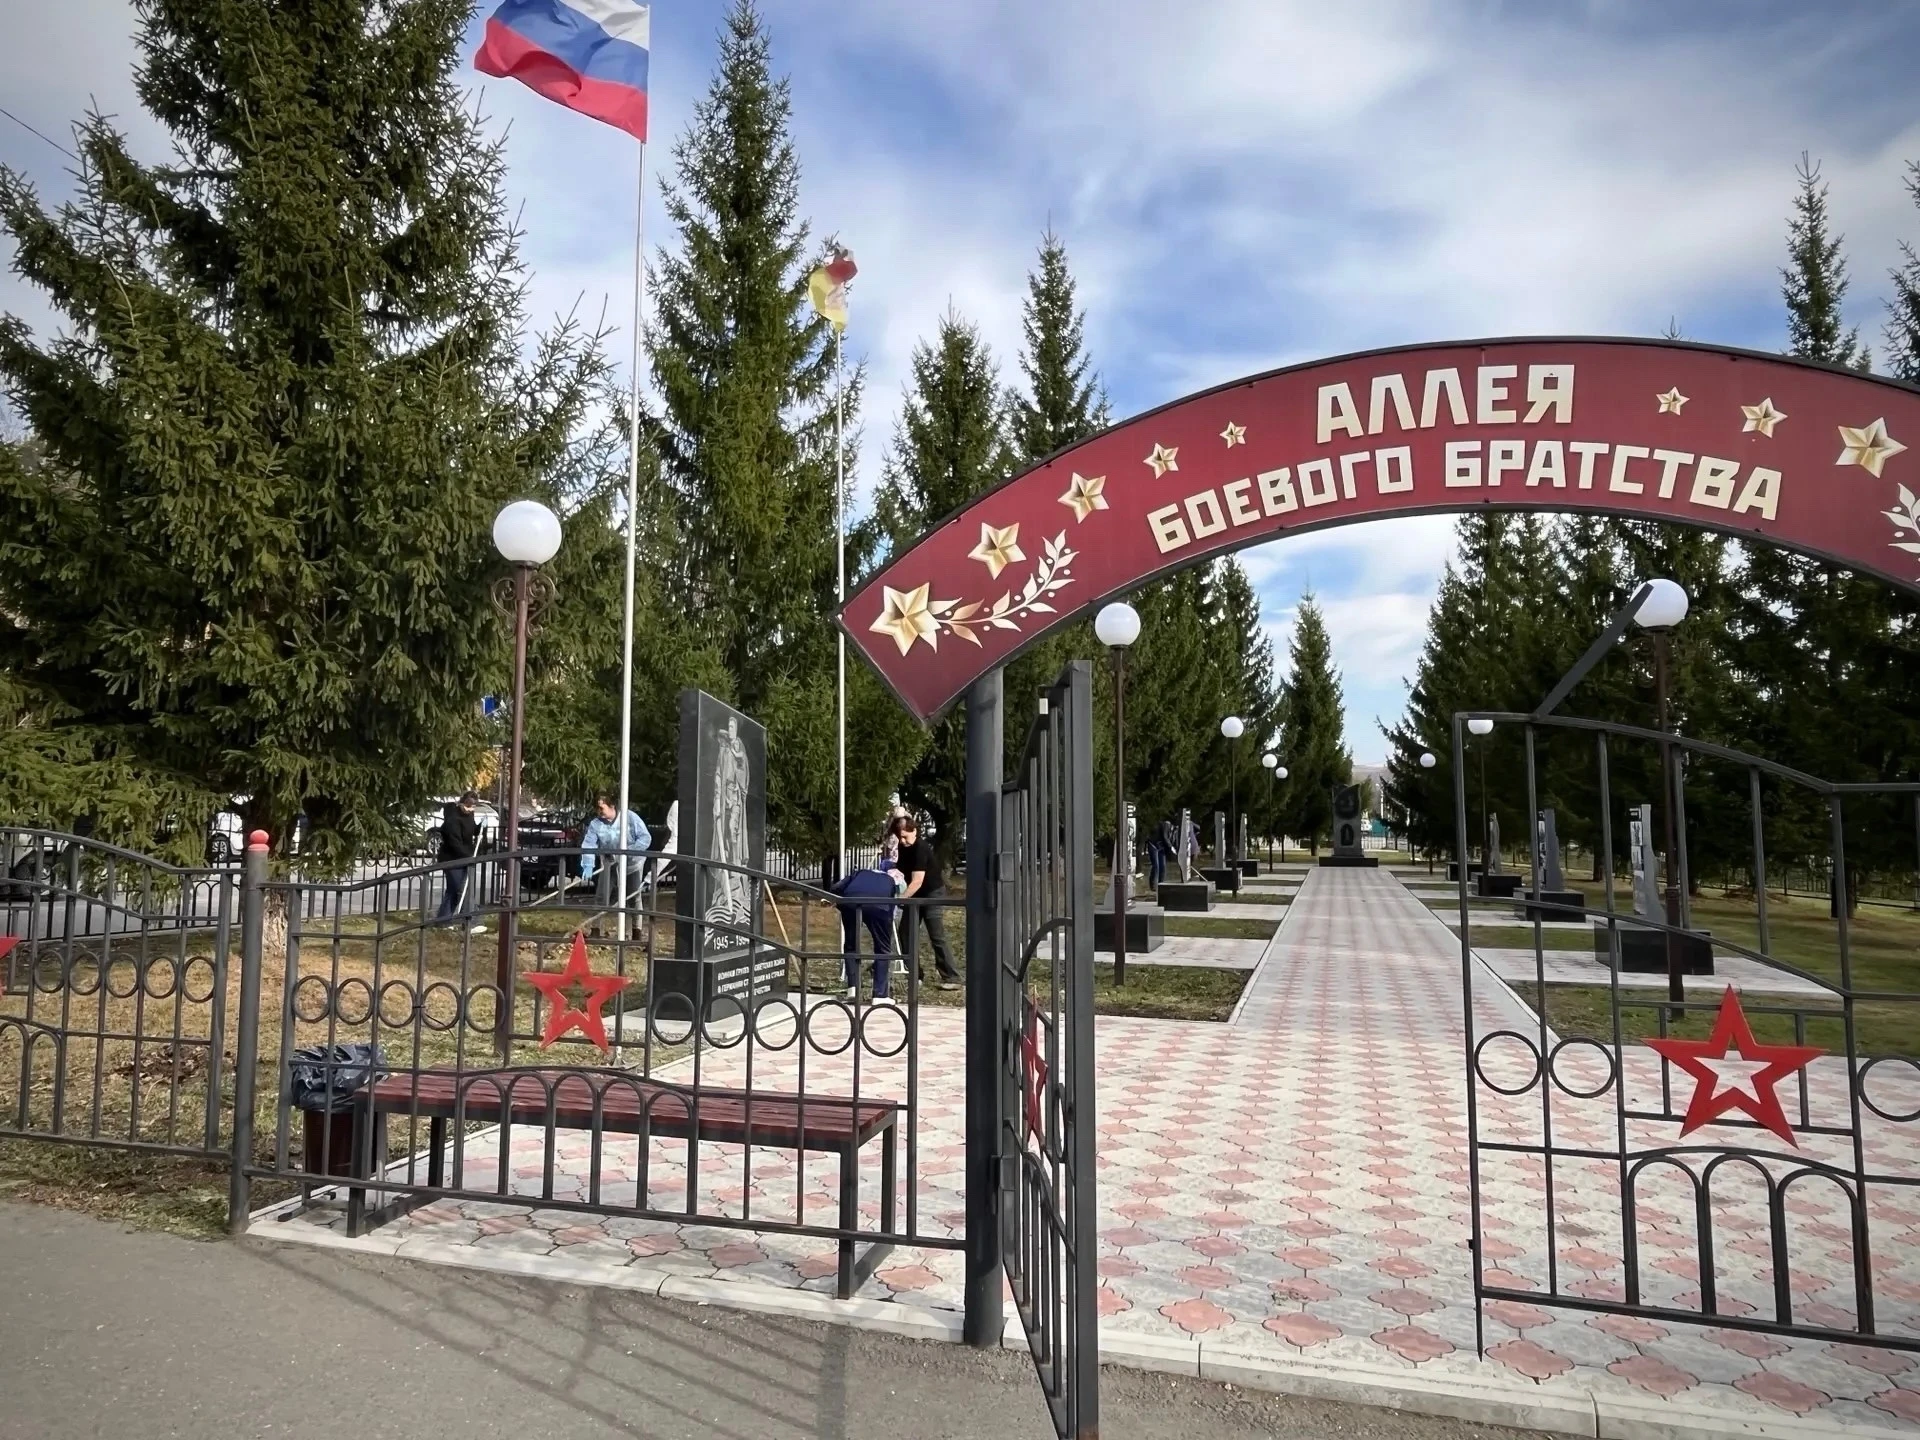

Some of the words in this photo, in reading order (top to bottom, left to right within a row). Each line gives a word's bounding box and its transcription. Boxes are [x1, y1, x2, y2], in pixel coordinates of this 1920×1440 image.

[1317, 364, 1575, 443] АЛЛЕЯ
[1147, 446, 1414, 554] БОЕВОГО
[1445, 440, 1783, 520] БРАТСТВА
[713, 935, 728, 950] 1945
